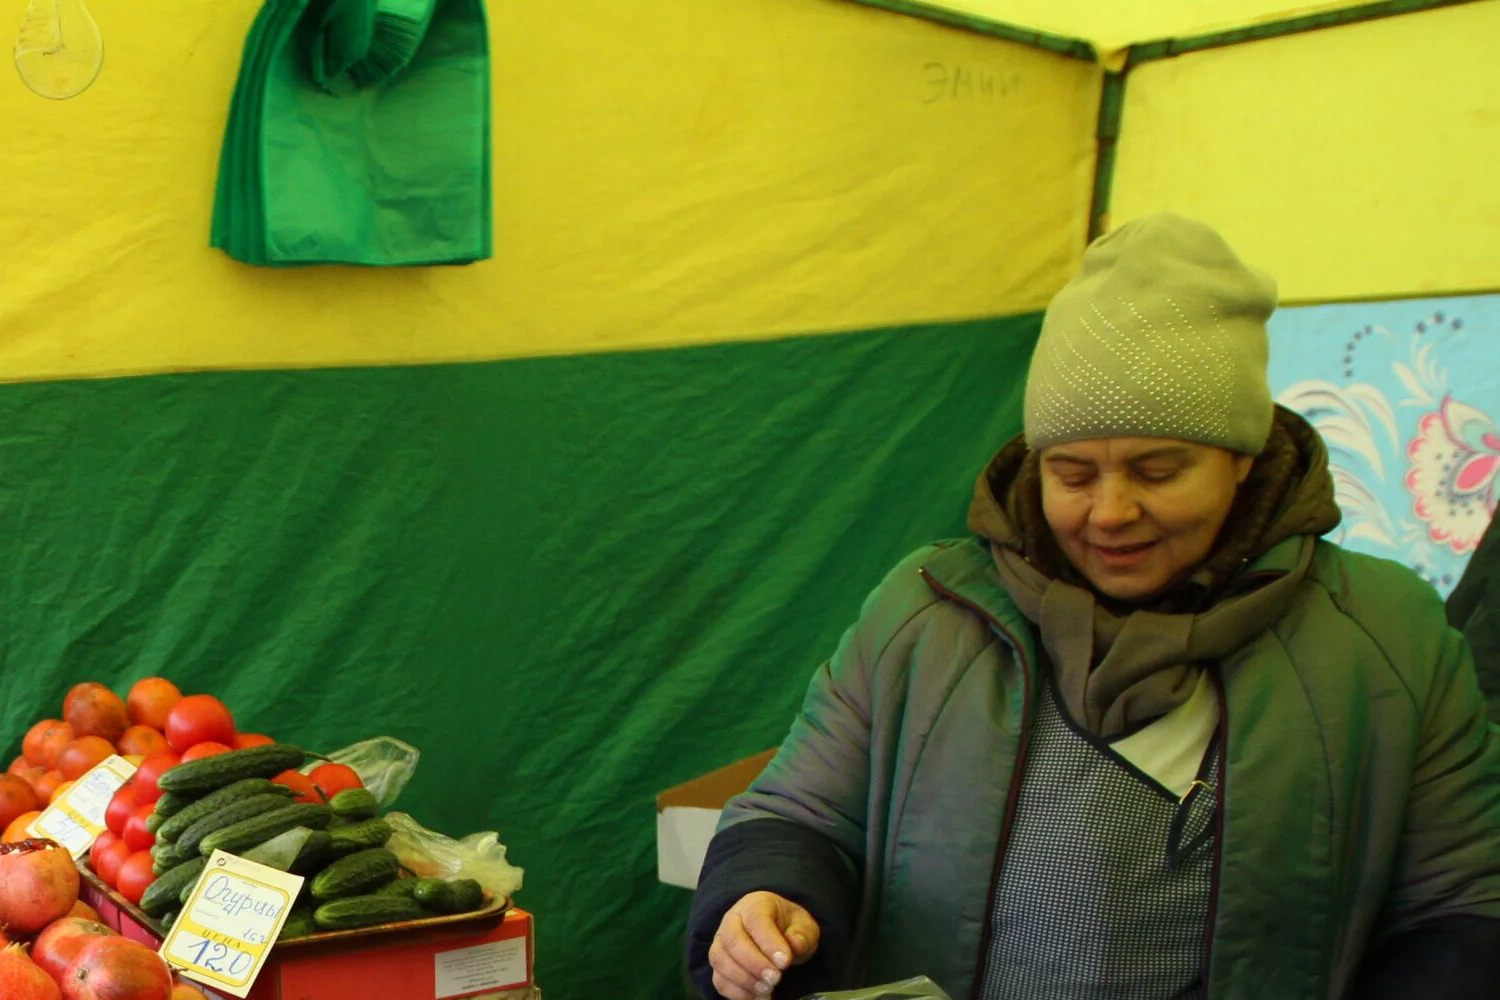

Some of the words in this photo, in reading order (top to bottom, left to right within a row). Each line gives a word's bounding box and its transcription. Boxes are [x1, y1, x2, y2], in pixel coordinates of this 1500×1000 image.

[204, 875, 284, 919] Огурцы
[187, 939, 252, 976] 120
[202, 929, 242, 949] ЦЕНА
